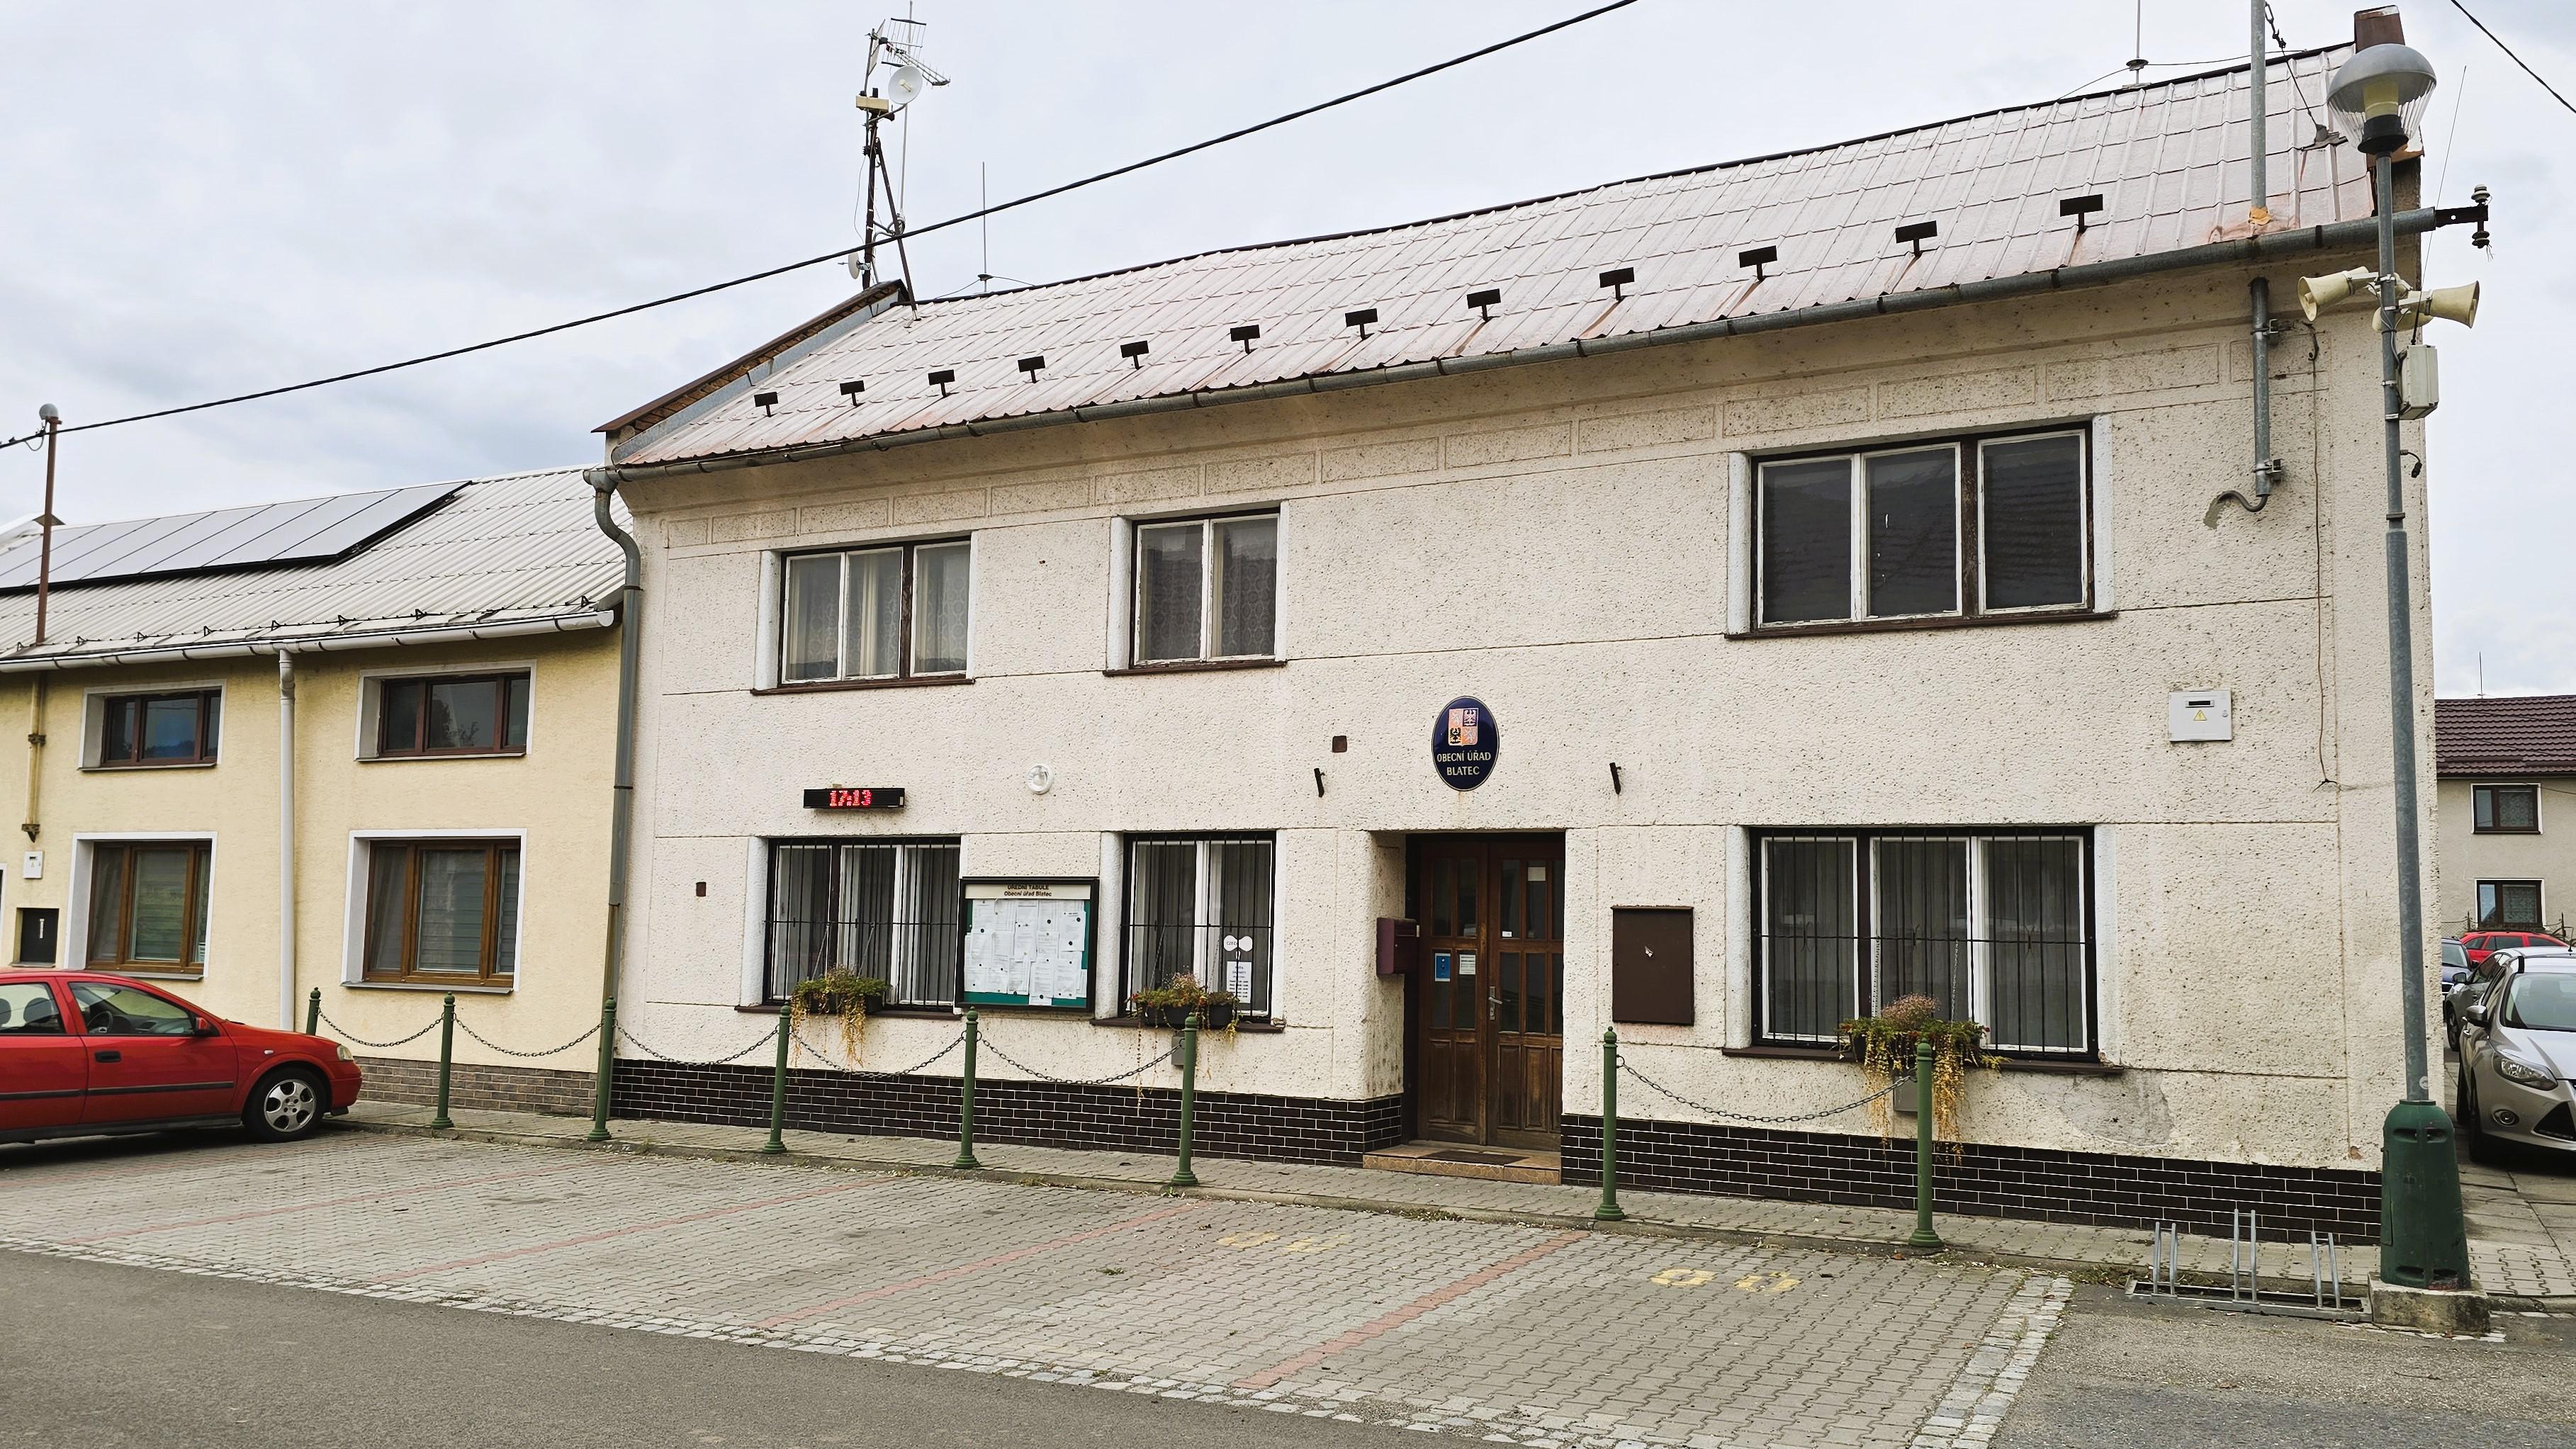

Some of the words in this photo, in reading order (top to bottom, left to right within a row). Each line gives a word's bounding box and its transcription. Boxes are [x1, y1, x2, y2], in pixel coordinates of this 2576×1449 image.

[1436, 750, 1465, 762] OBECNÍ
[1467, 750, 1492, 761] ÚŘAD
[1446, 766, 1480, 776] BLATEC
[829, 789, 872, 806] 17:13
